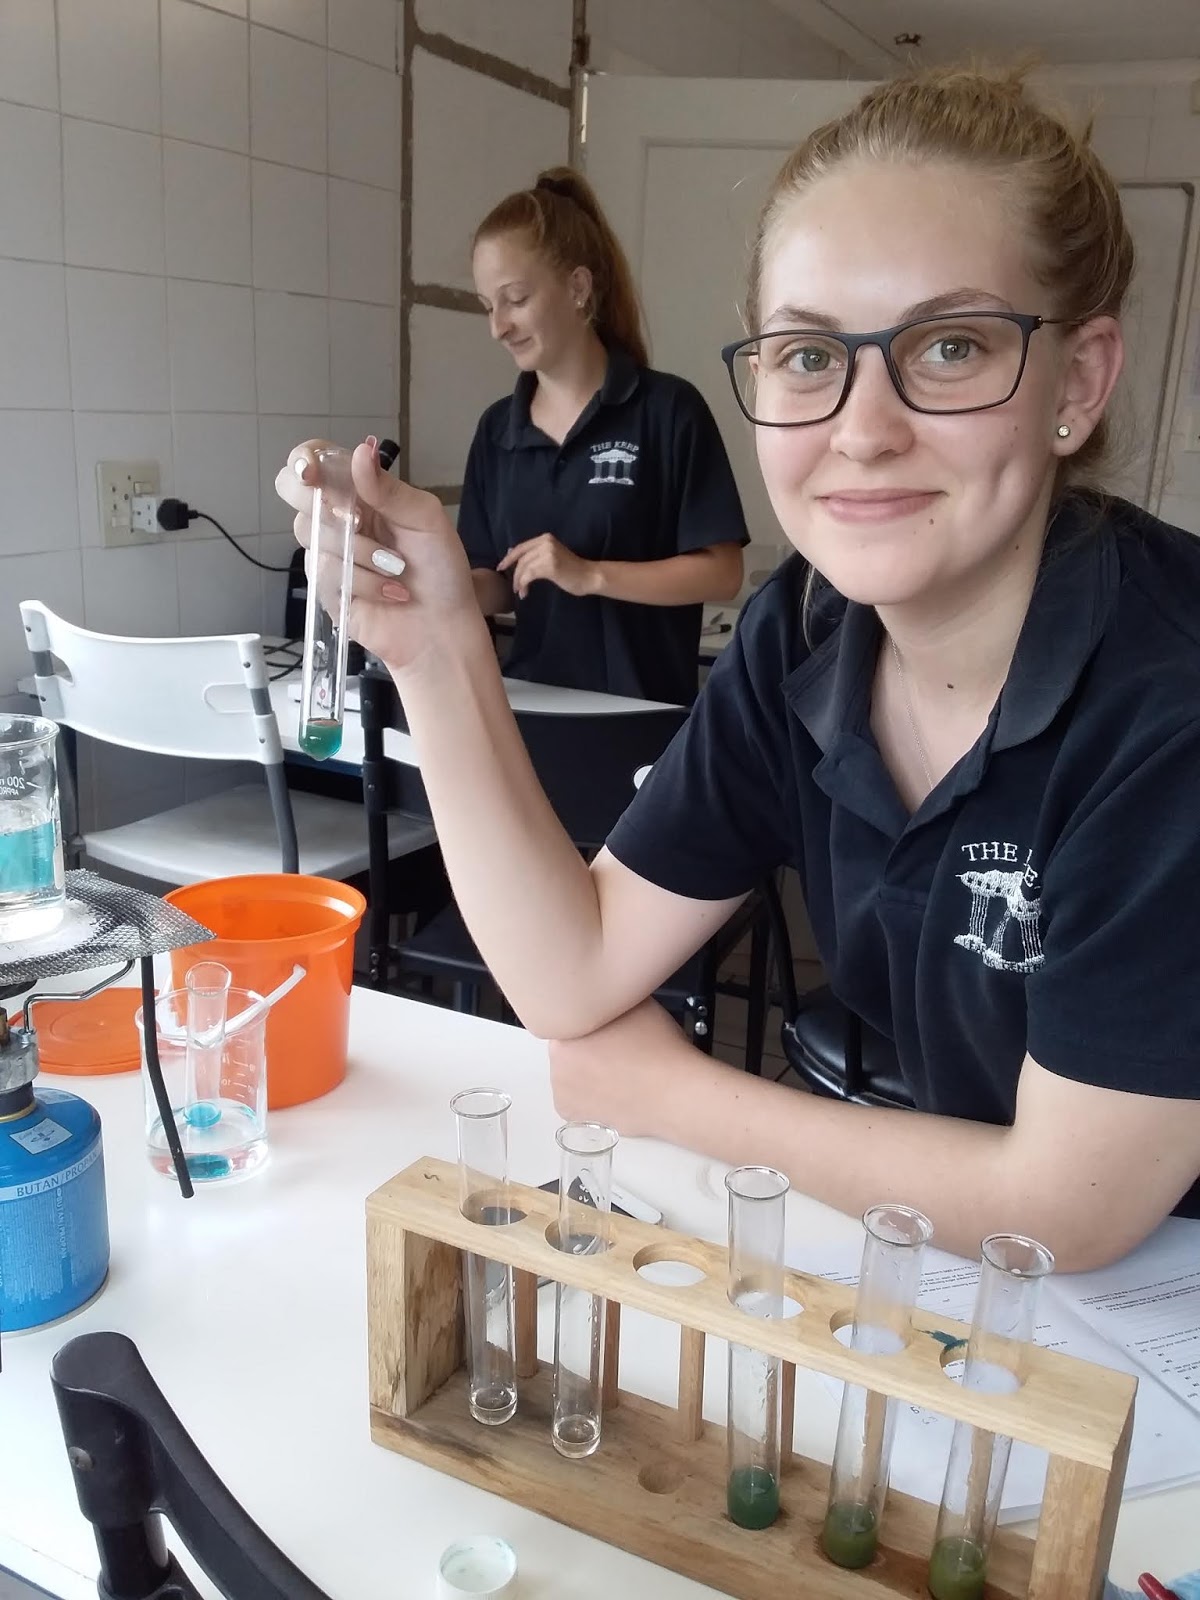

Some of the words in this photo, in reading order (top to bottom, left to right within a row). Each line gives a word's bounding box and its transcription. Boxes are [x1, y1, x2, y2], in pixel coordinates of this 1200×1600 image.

[590, 441, 611, 452] THE
[614, 441, 639, 452] KEEP
[961, 841, 1018, 862] THE
